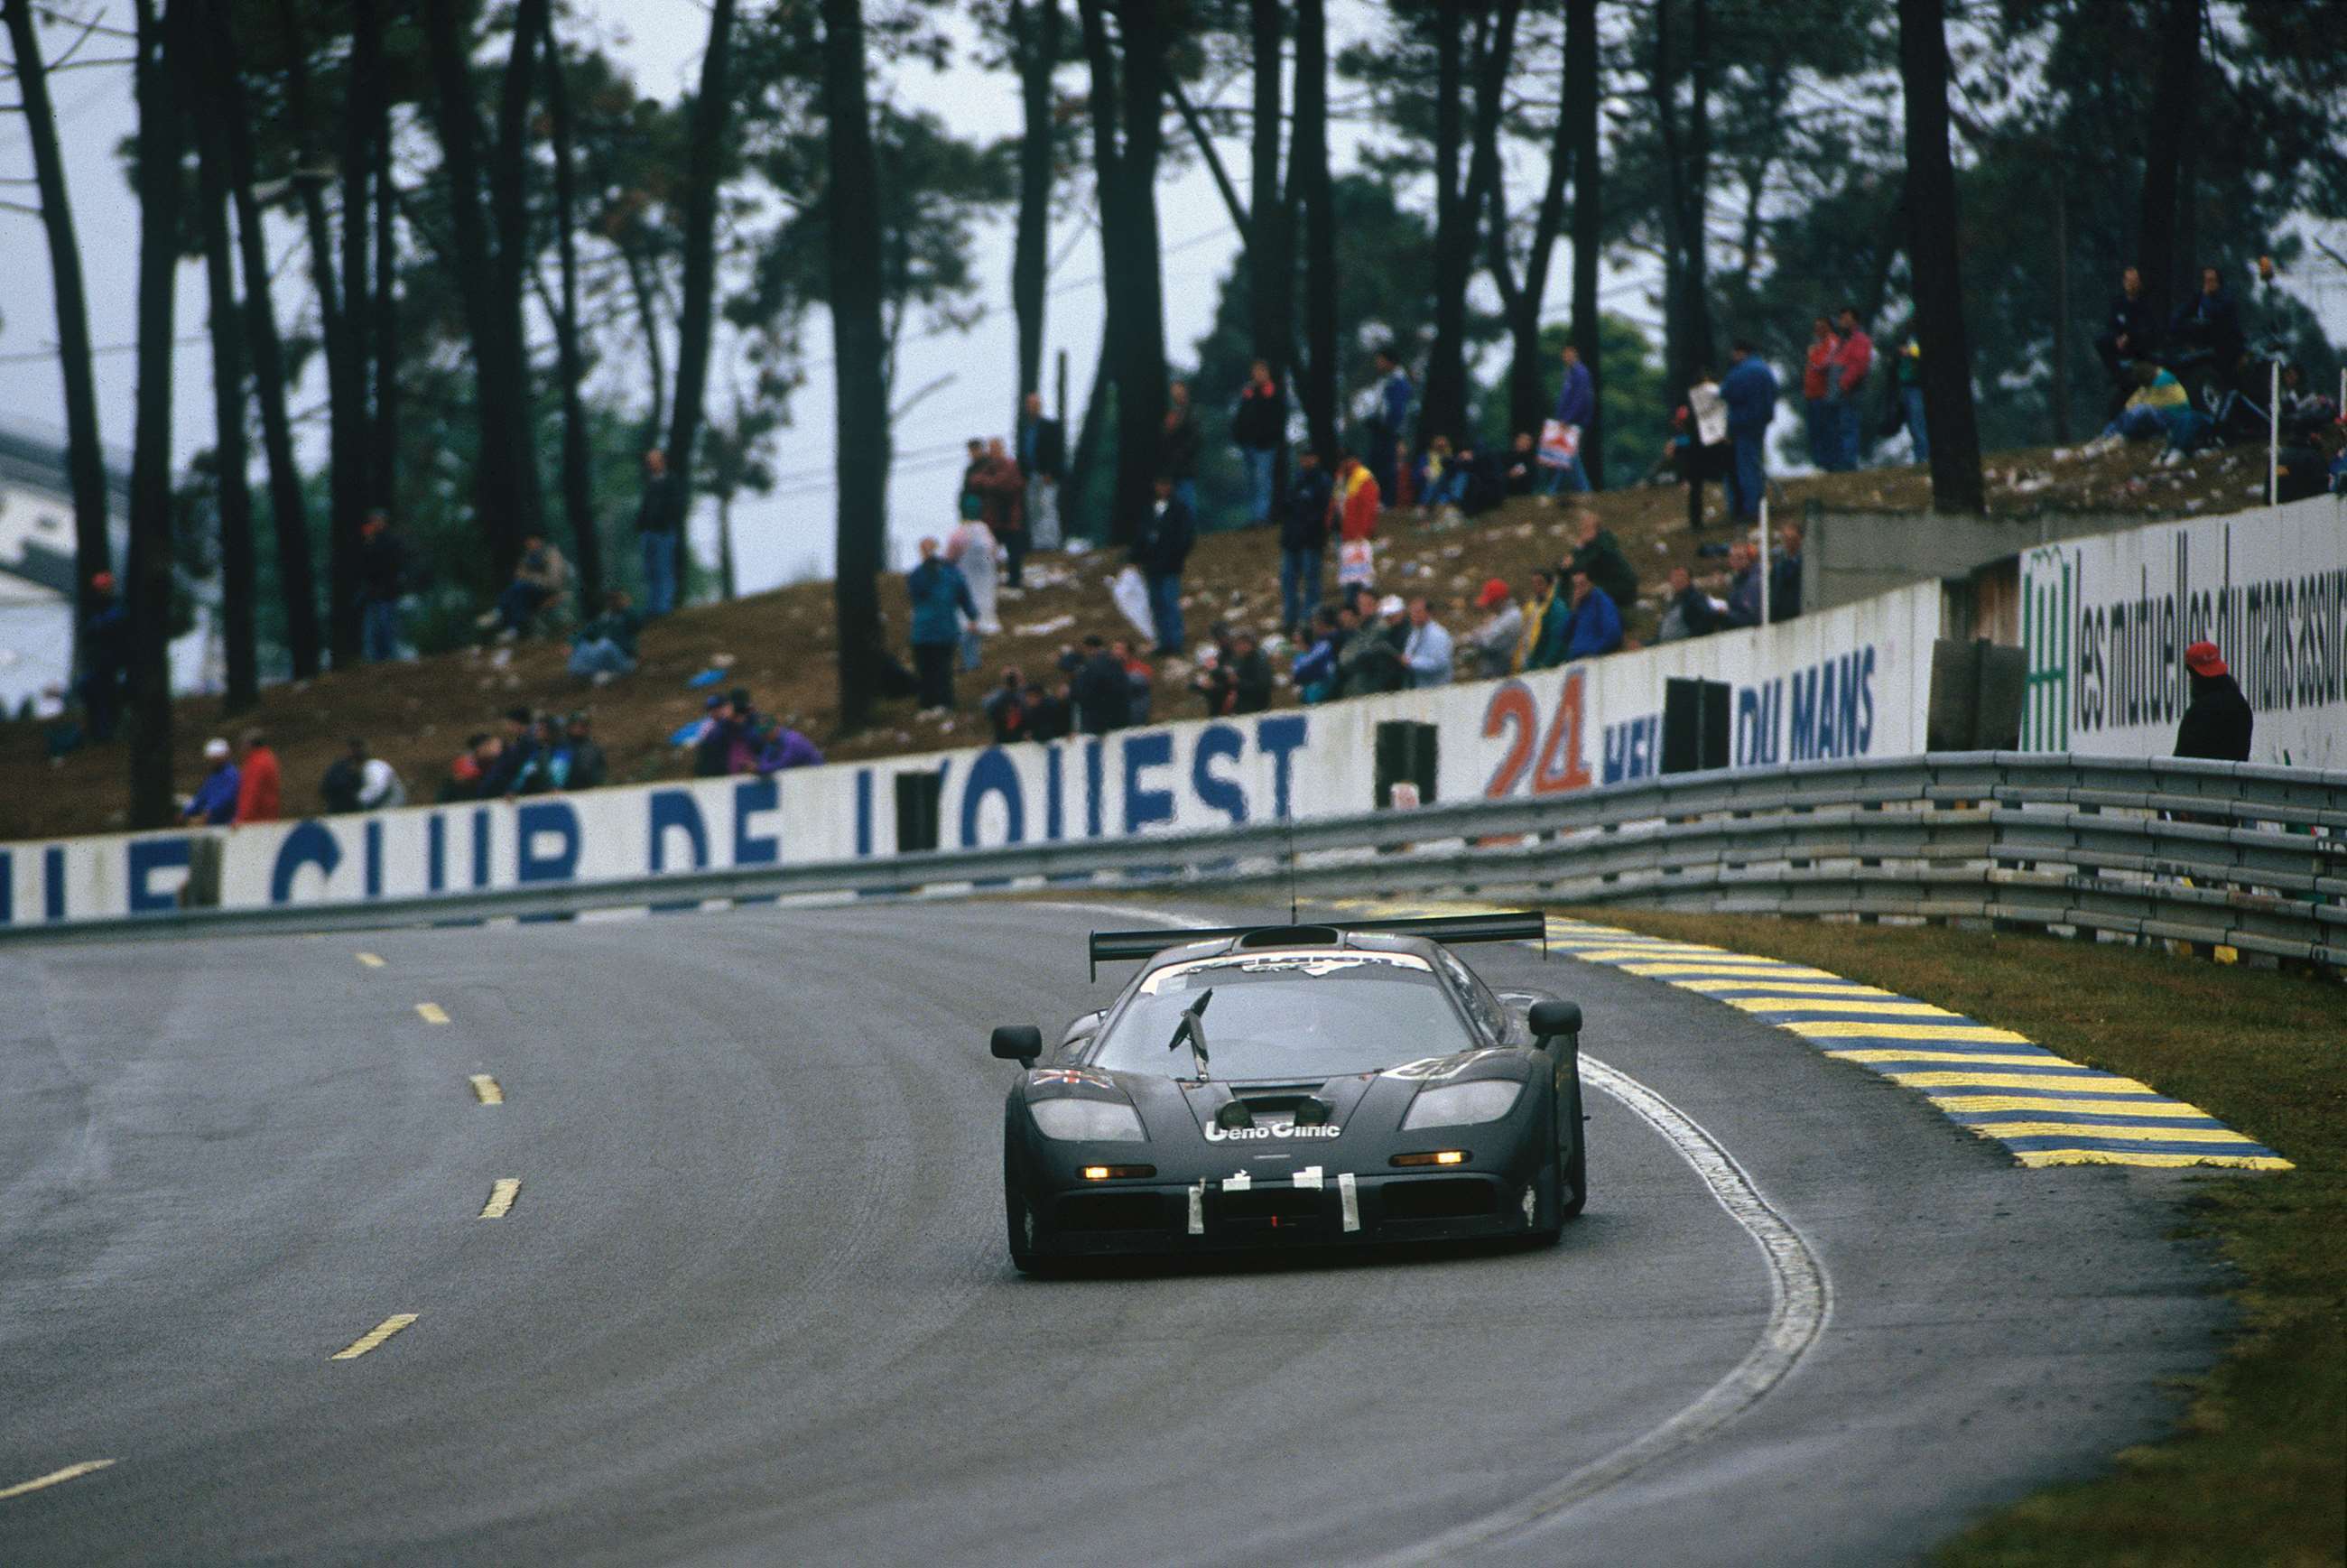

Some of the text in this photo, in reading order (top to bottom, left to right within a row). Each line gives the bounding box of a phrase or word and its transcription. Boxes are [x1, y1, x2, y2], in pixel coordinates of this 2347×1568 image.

[2073, 548, 2105, 731] les
[2217, 523, 2244, 691] du
[2247, 578, 2294, 711] mans
[1483, 666, 1591, 799] 24
[1737, 677, 1783, 766] DU
[1789, 642, 1876, 761] MANS
[272, 801, 580, 905] CLUB
[649, 779, 779, 873] DE
[1204, 1120, 1341, 1142] Ueno Clinic
